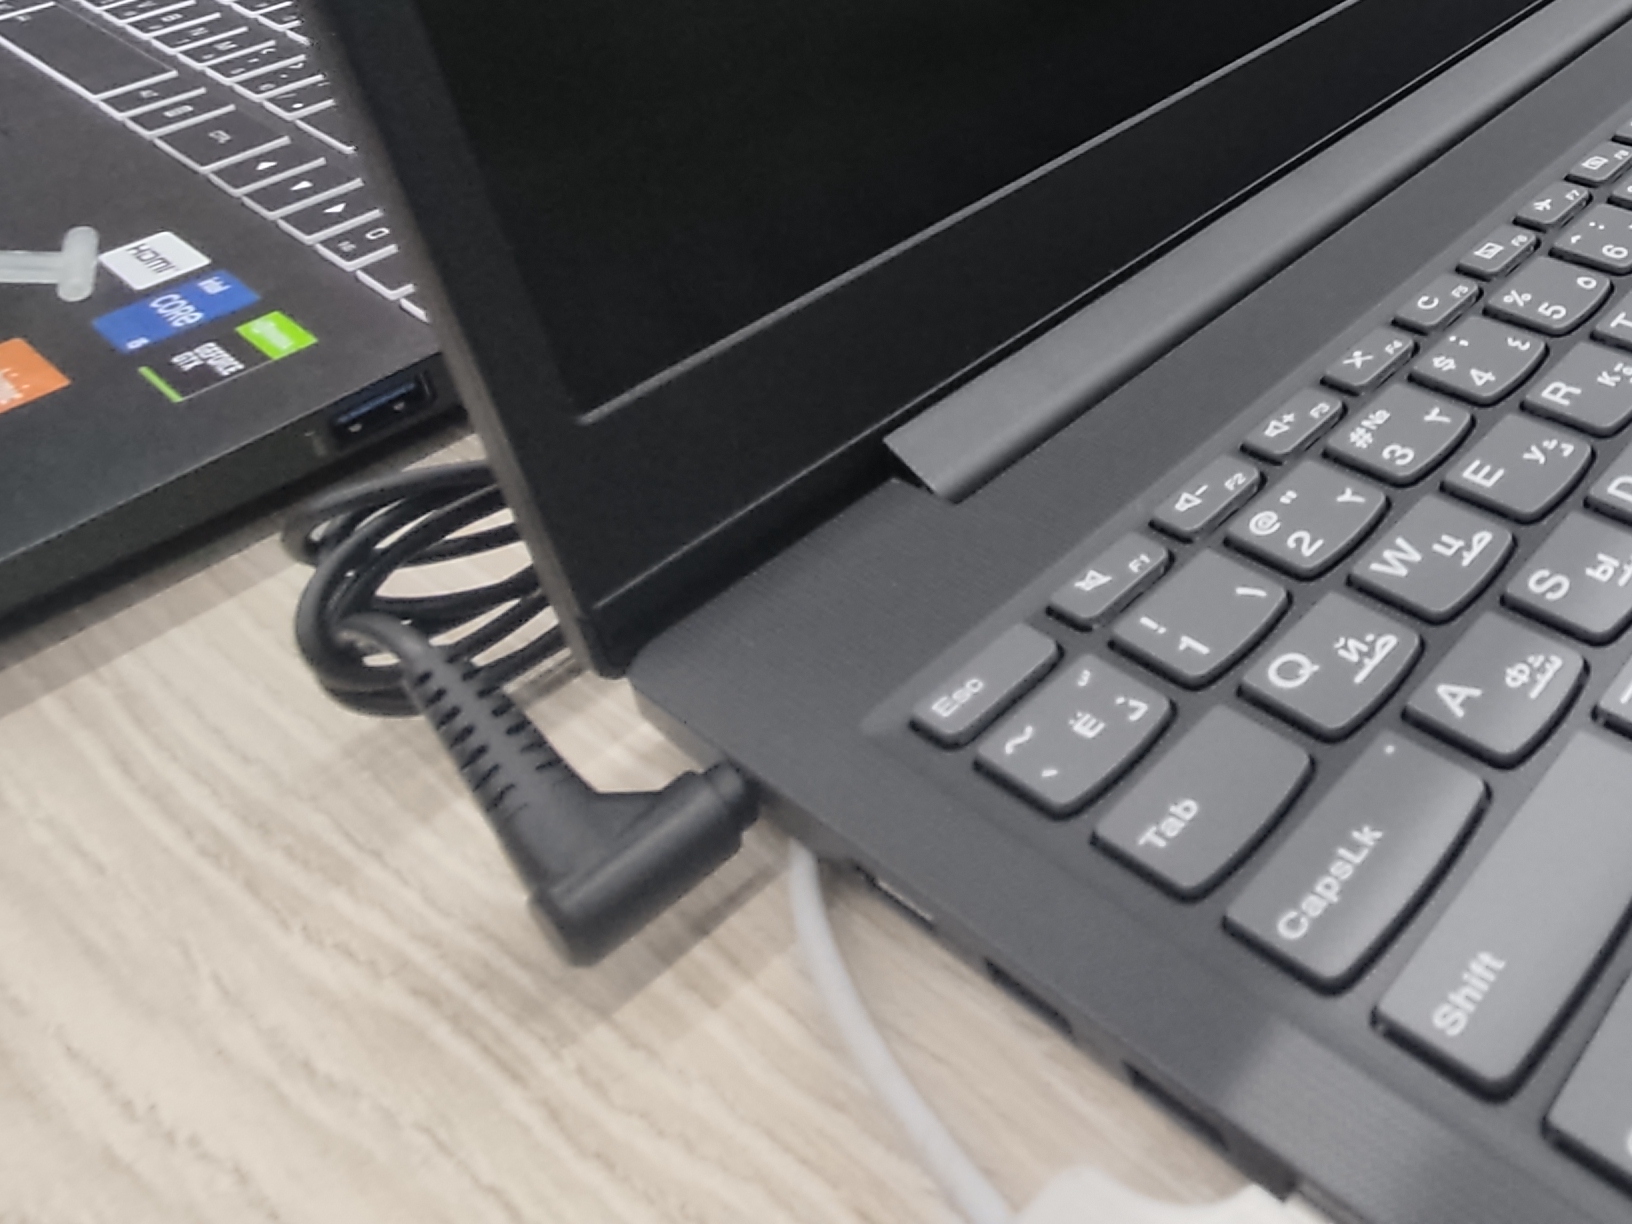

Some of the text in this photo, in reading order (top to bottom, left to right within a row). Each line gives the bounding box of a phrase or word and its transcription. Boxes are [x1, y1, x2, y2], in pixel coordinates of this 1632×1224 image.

[1601, 243, 1629, 260] 6
[1537, 301, 1567, 320] 5
[1469, 368, 1496, 387] 4
[1540, 381, 1582, 407] R
[1381, 443, 1415, 466] 3
[1461, 459, 1505, 489] E
[1286, 530, 1325, 558] 2
[1369, 536, 1422, 577] W
[1527, 568, 1570, 601] S
[1178, 635, 1211, 655] 1
[1267, 652, 1320, 689] Q
[931, 677, 985, 718] Esc
[1436, 683, 1483, 718] A
[1138, 799, 1199, 848] Tab
[1277, 825, 1383, 940] CapsLk
[1433, 953, 1505, 1035] Shift
